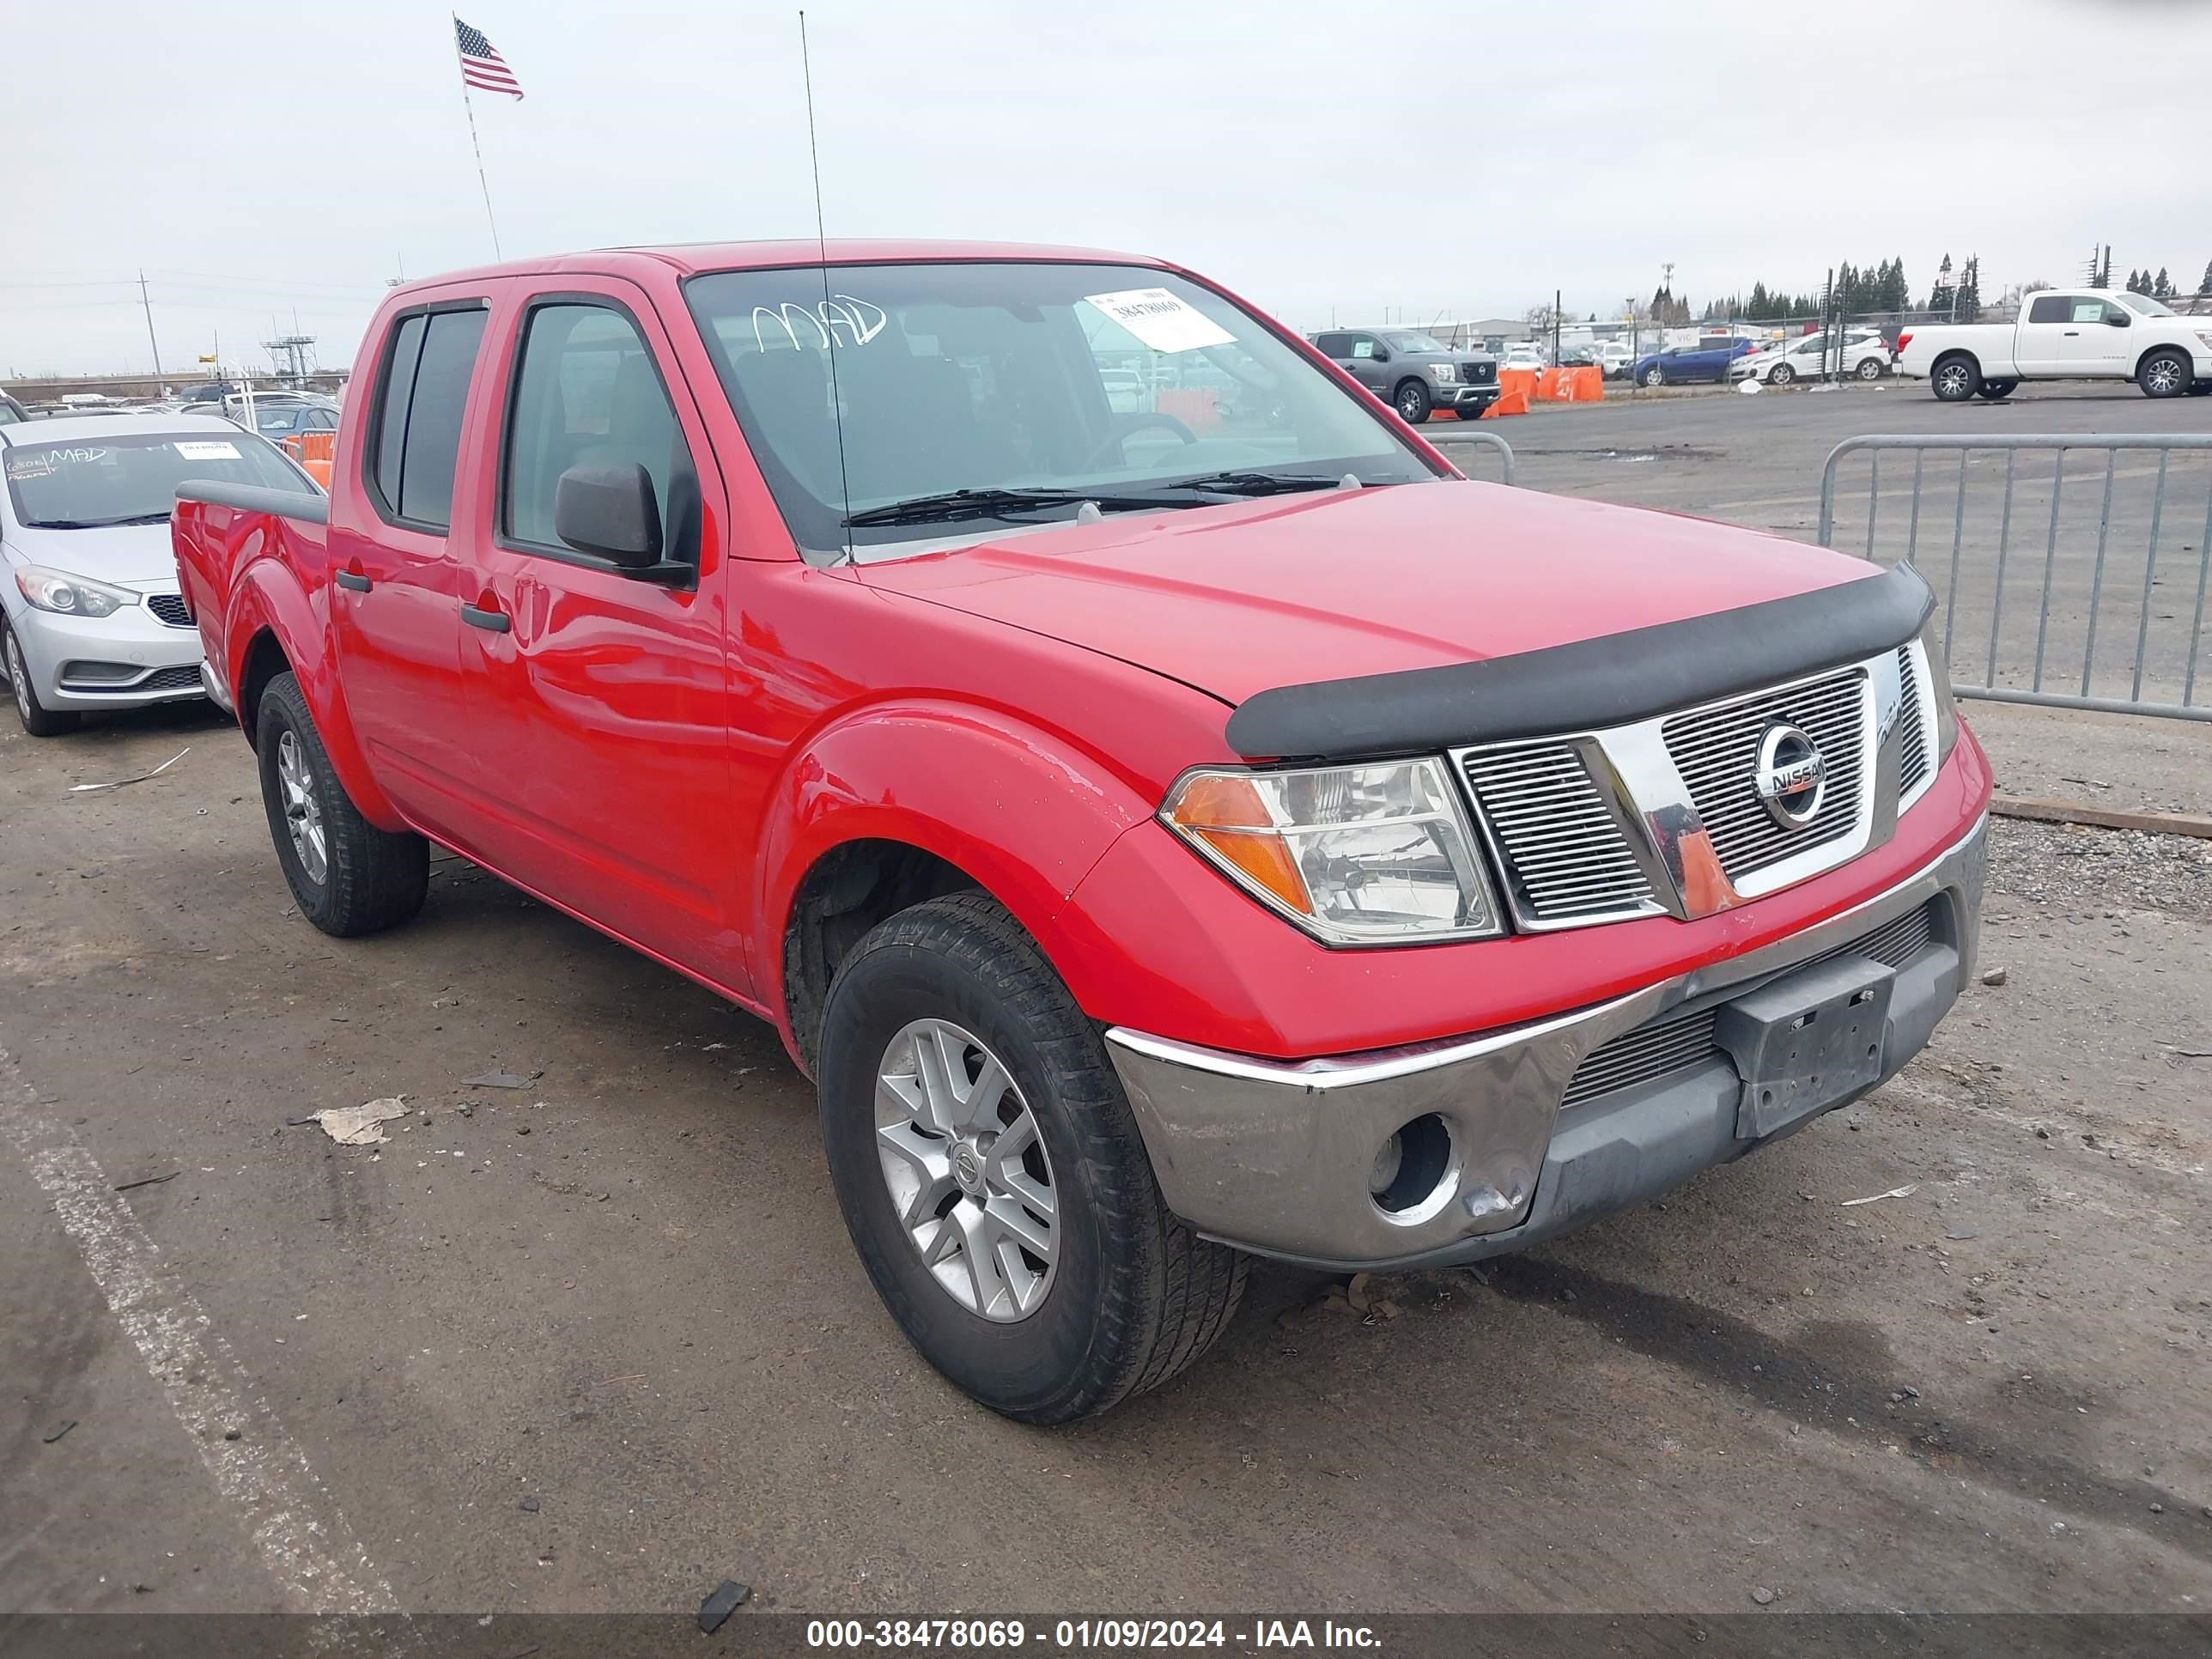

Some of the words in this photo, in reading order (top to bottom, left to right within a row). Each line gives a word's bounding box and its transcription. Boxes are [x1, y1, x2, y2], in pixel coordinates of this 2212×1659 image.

[752, 295, 887, 353] MAD
[1113, 301, 1182, 319] 38478069
[1772, 760, 1824, 790] NISSAN
